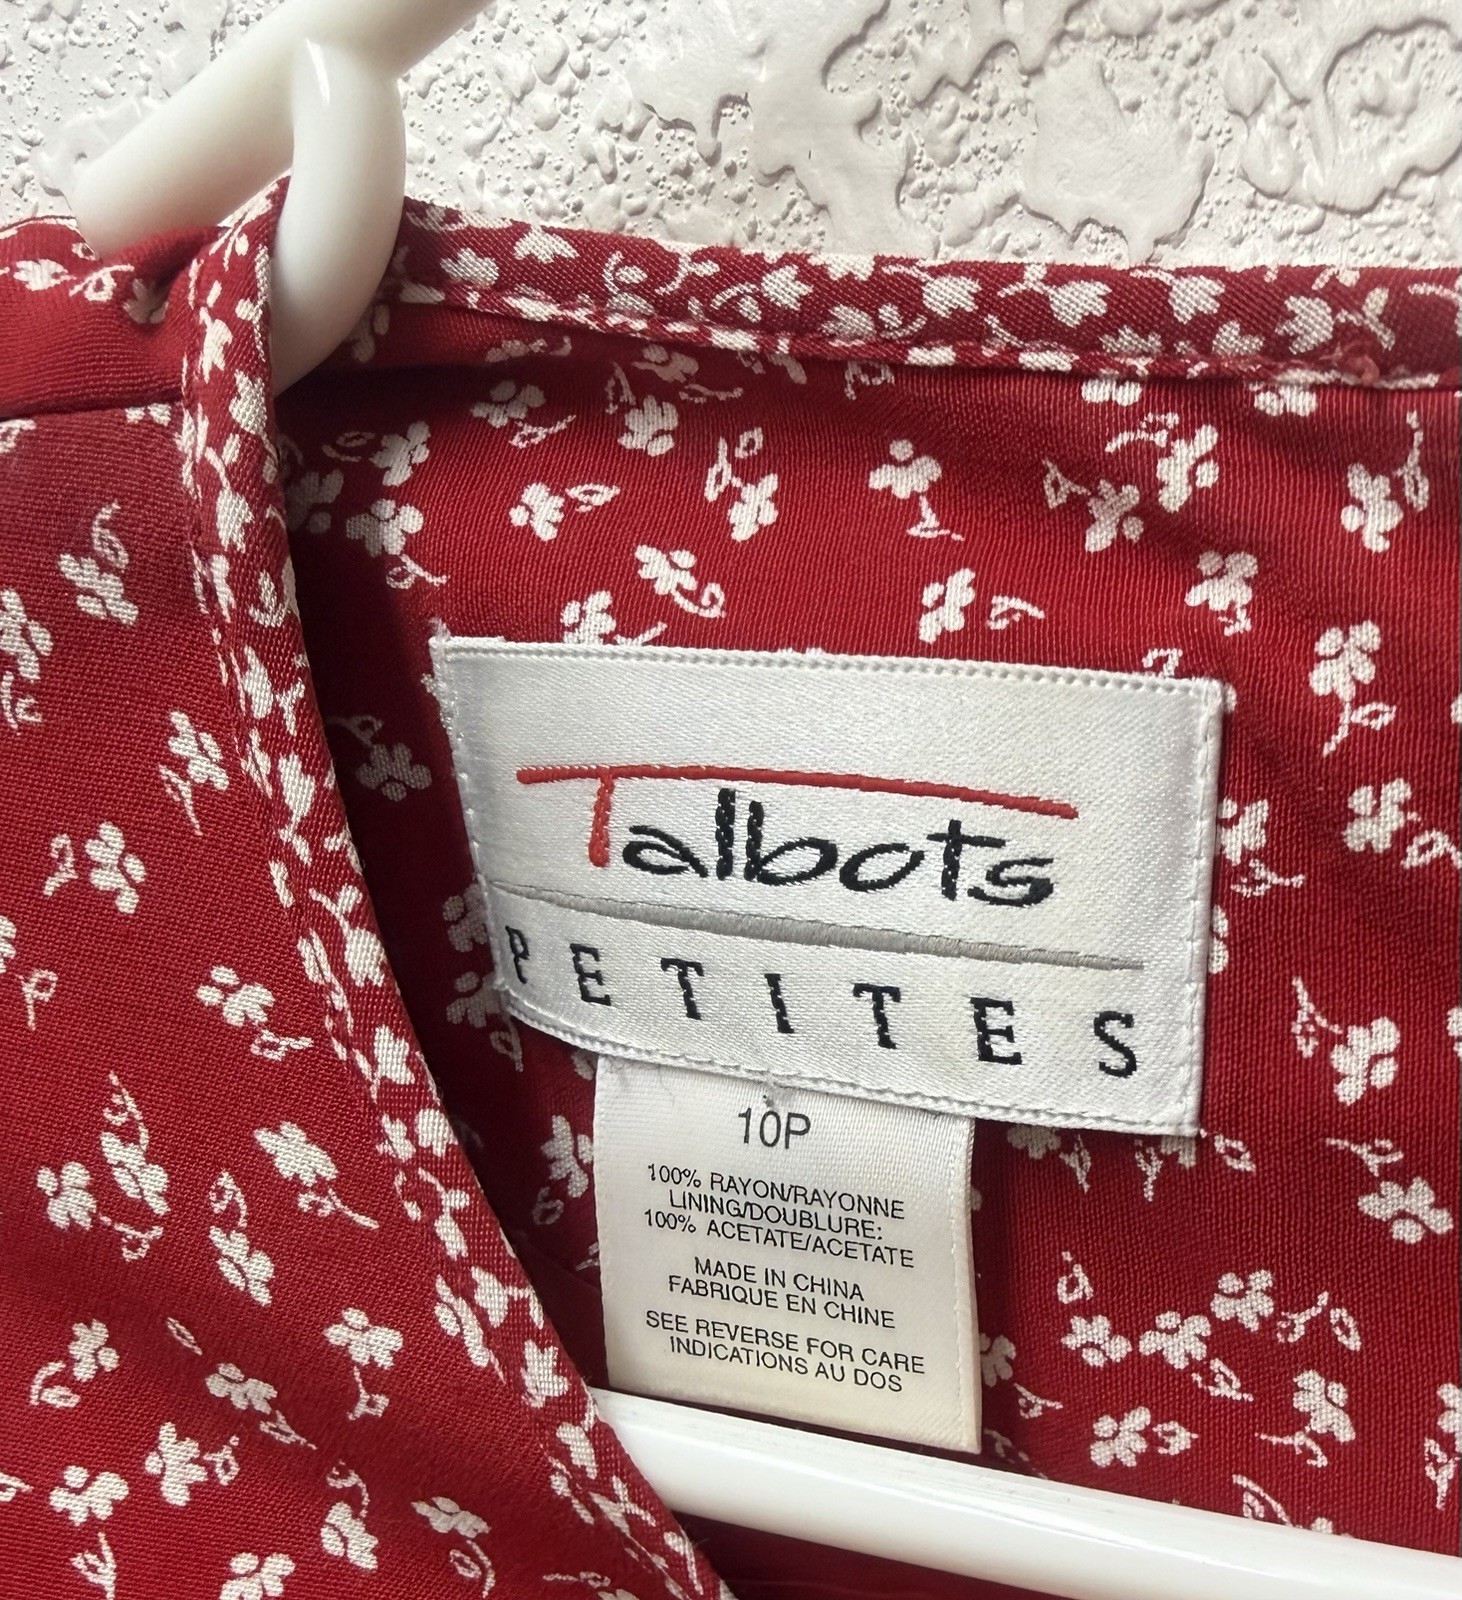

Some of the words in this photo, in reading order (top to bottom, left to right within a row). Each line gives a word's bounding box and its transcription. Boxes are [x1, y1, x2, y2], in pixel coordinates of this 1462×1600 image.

[515, 763, 1079, 907] Talbots
[504, 924, 1138, 1079] PETITES
[738, 1107, 811, 1150] 10P
[647, 1163, 702, 1188] 100%
[710, 1172, 905, 1220] RAYON/RAYONNE
[669, 1189, 883, 1241] LINING/DOUBLURE:
[643, 1210, 697, 1234] 100%
[706, 1220, 914, 1268] ACETATE/ACETATE
[668, 1275, 778, 1309] FABRIQUE
[786, 1294, 816, 1316] EN
[823, 1300, 896, 1329] CHINE
[694, 1257, 757, 1284] MADE
[764, 1268, 786, 1288] IN
[793, 1273, 865, 1302] CHINA
[645, 1310, 688, 1333] SEE
[695, 1319, 799, 1351] REVERSE
[806, 1337, 854, 1362] FOR
[861, 1346, 925, 1374] CARE
[670, 1337, 809, 1375] INDICATIONS
[815, 1361, 845, 1383] AU
[854, 1368, 902, 1392] DOS
